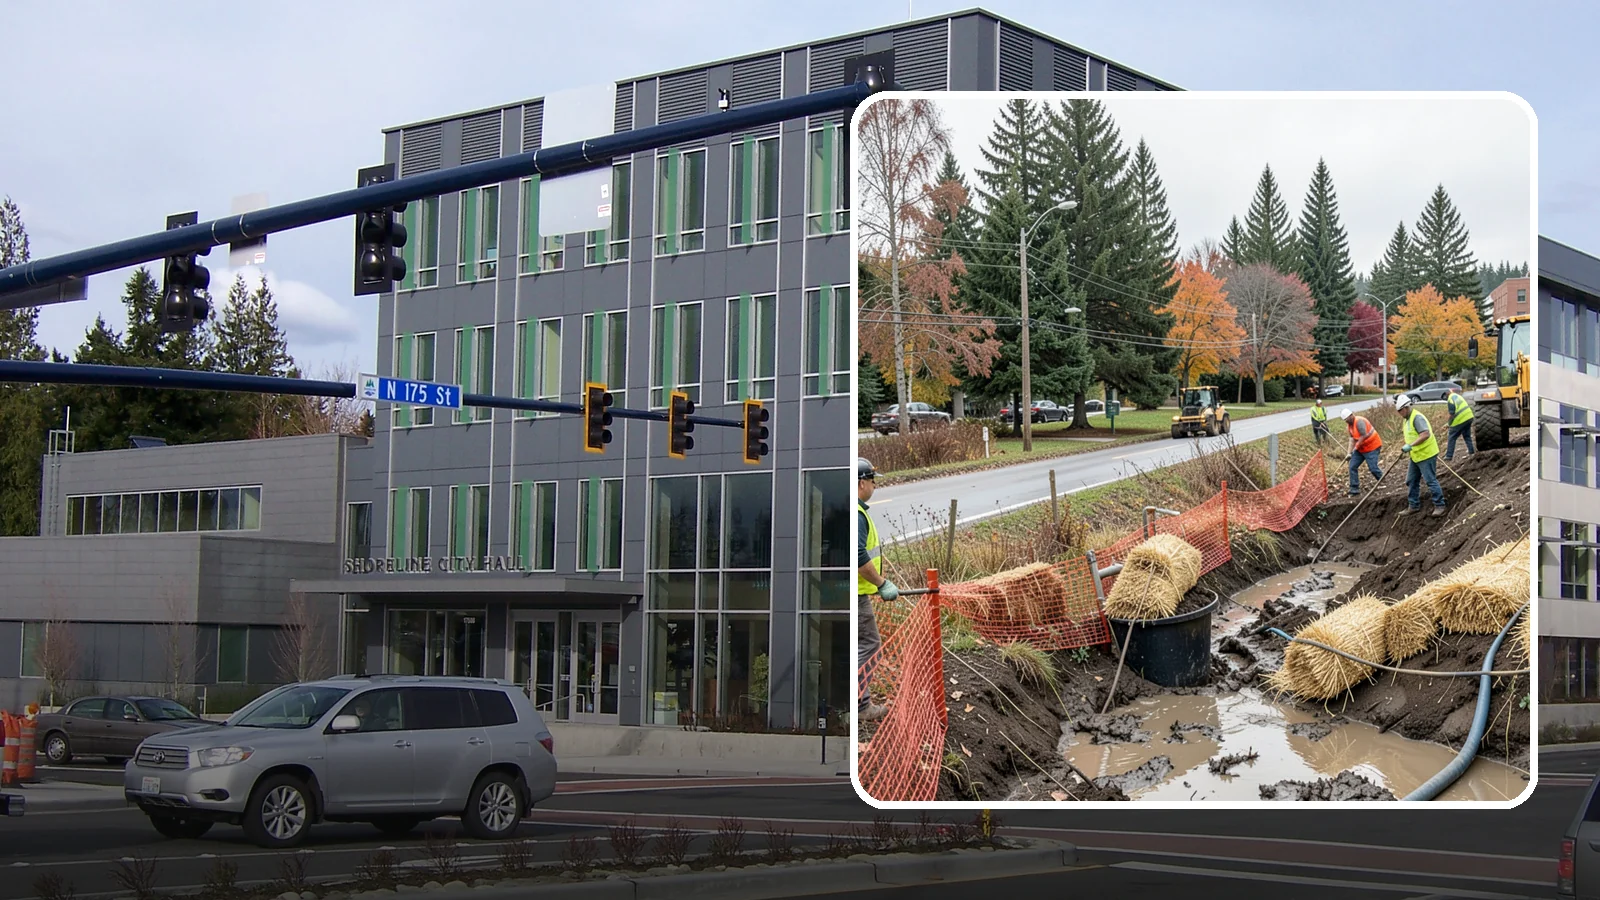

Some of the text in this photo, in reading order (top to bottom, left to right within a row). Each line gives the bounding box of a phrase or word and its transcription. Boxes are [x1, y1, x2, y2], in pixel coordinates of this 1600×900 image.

[387, 380, 451, 406] N 175 St
[343, 556, 525, 574] SHORELINE CITY HALL
